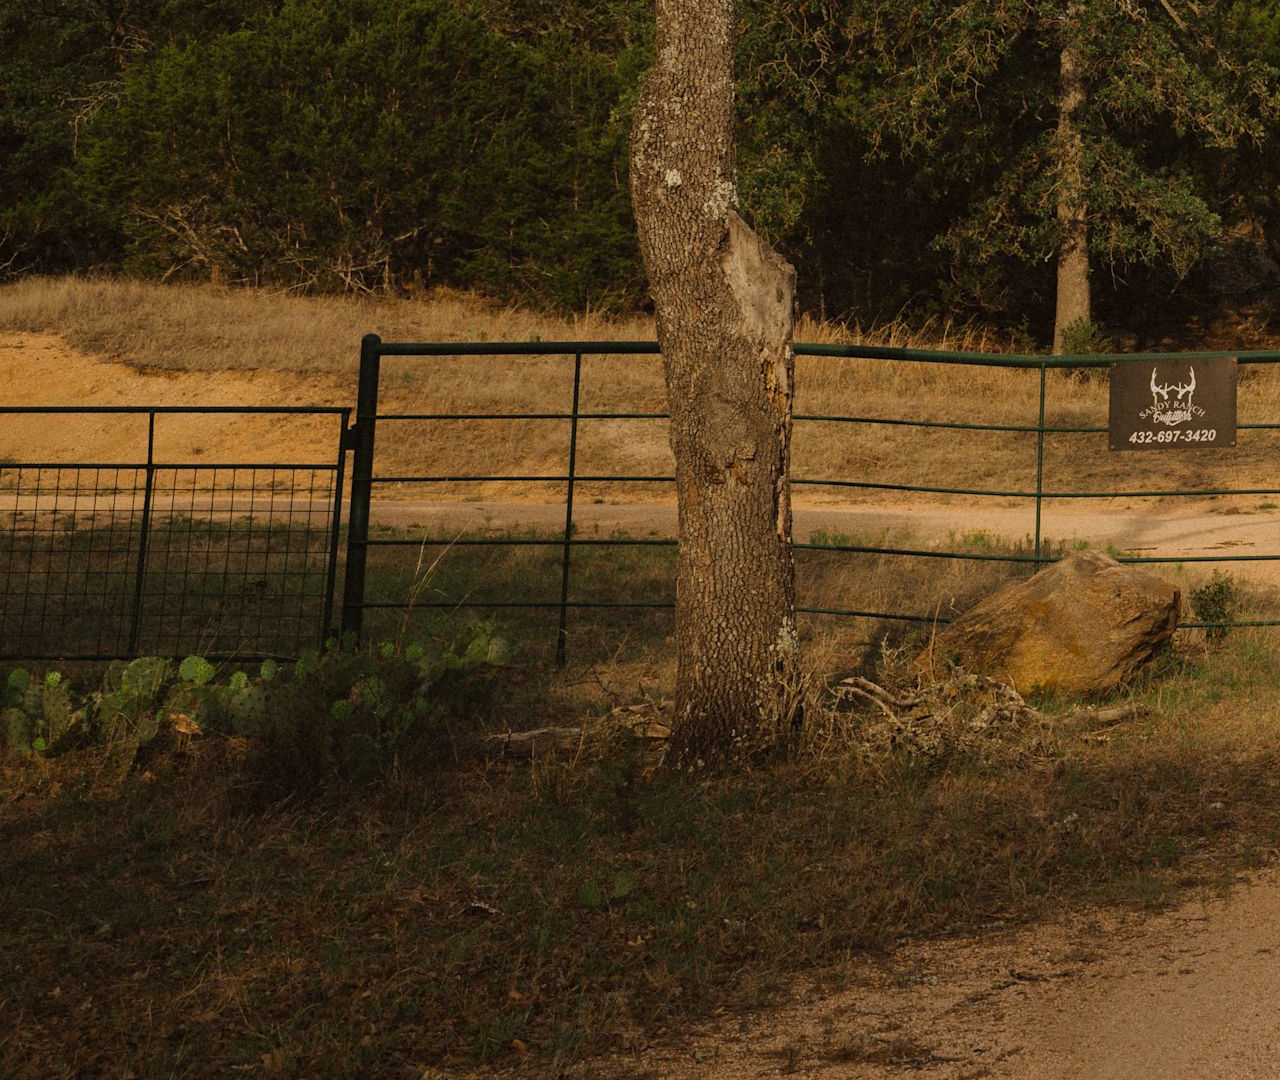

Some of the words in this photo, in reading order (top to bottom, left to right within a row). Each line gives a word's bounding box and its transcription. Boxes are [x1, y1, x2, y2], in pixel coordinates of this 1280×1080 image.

[1139, 401, 1170, 419] SANDY
[1173, 401, 1206, 417] RANCH
[1129, 429, 1216, 443] 432-697-3420
